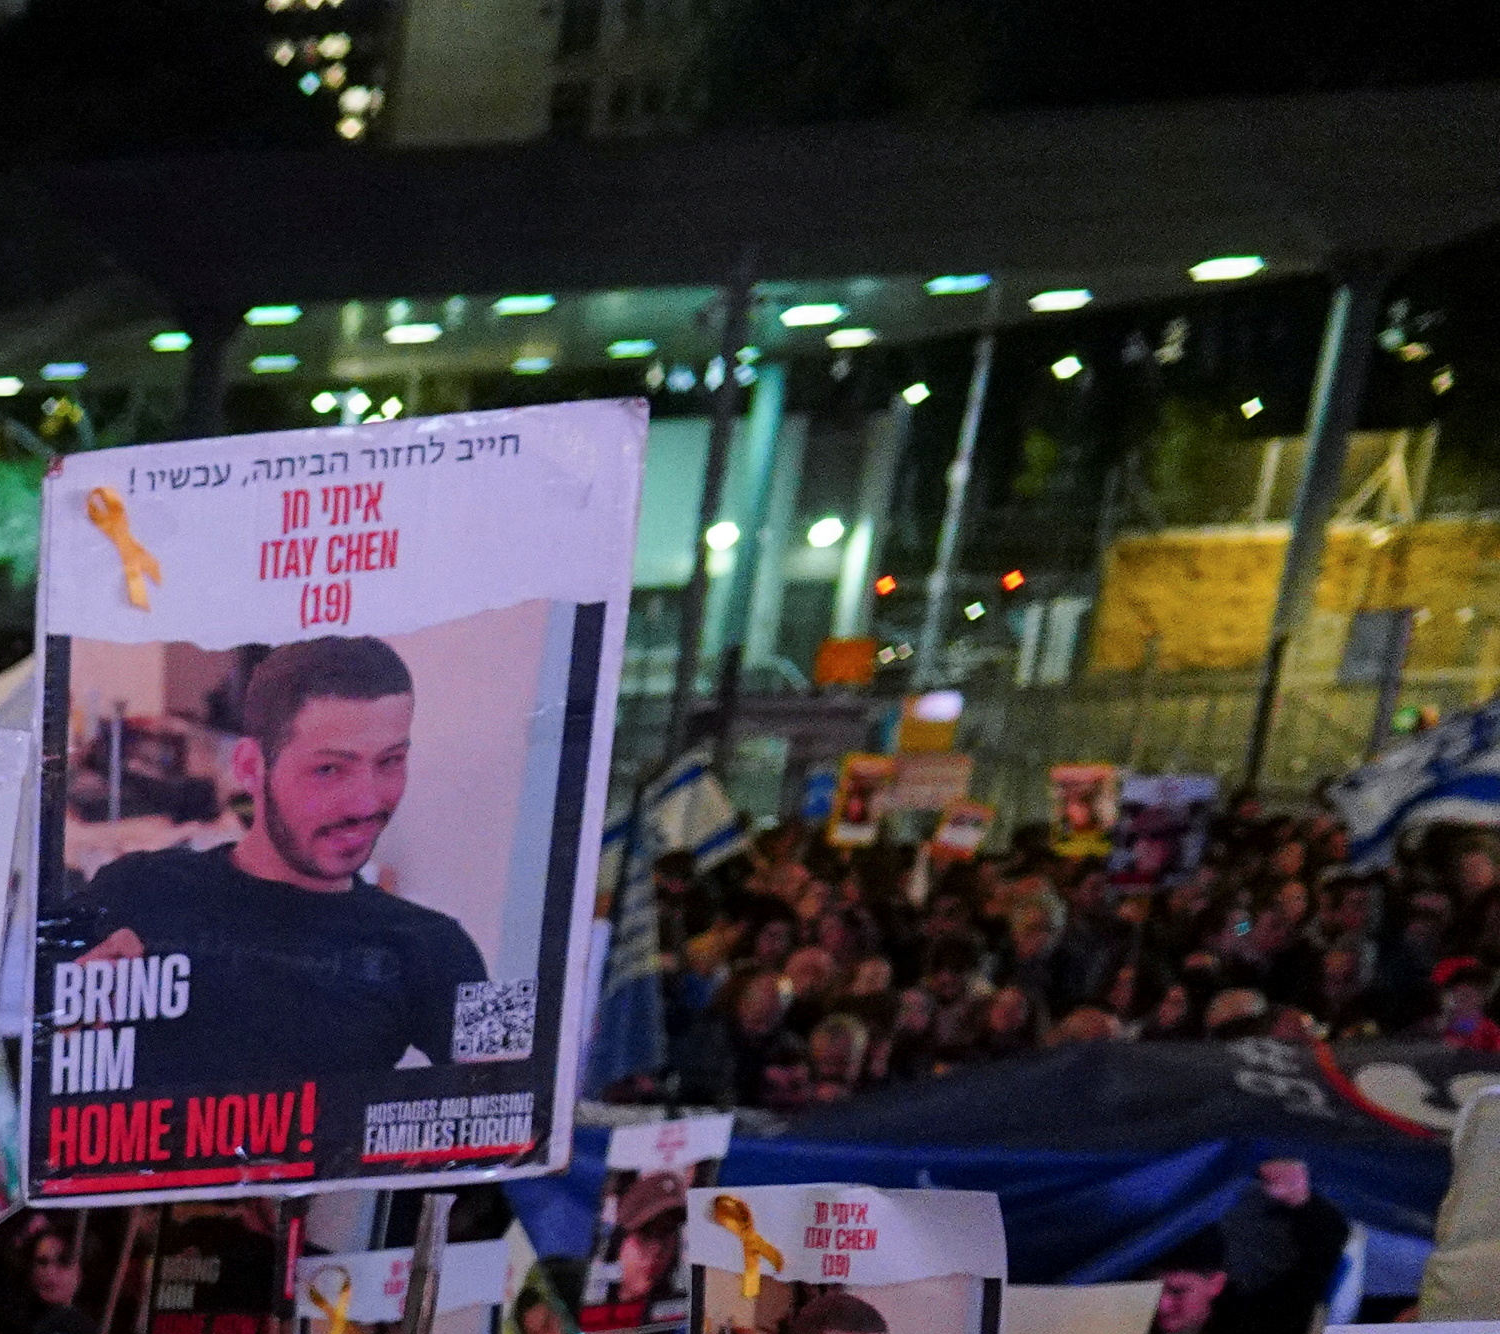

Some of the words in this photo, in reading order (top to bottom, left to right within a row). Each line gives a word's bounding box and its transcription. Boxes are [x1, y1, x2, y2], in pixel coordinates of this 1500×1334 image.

[242, 451, 348, 486] הביתה,
[367, 437, 445, 469] לחזור
[456, 434, 519, 461] חייב
[146, 464, 231, 490] עכשיו
[282, 489, 310, 534] חן
[322, 482, 383, 526] איתי
[260, 537, 318, 580] ITAY
[327, 530, 398, 574] CHEN
[300, 580, 351, 629] (19)
[52, 954, 190, 1025] BRING
[51, 1028, 135, 1094] HIM
[49, 1099, 172, 1167] HOME
[185, 1082, 317, 1157] NOW!
[366, 1099, 440, 1125] HOSTAGES
[439, 1098, 471, 1121] AND
[471, 1092, 534, 1120] MISSING
[804, 1227, 832, 1249] ITAY
[836, 1228, 876, 1250] CHEN
